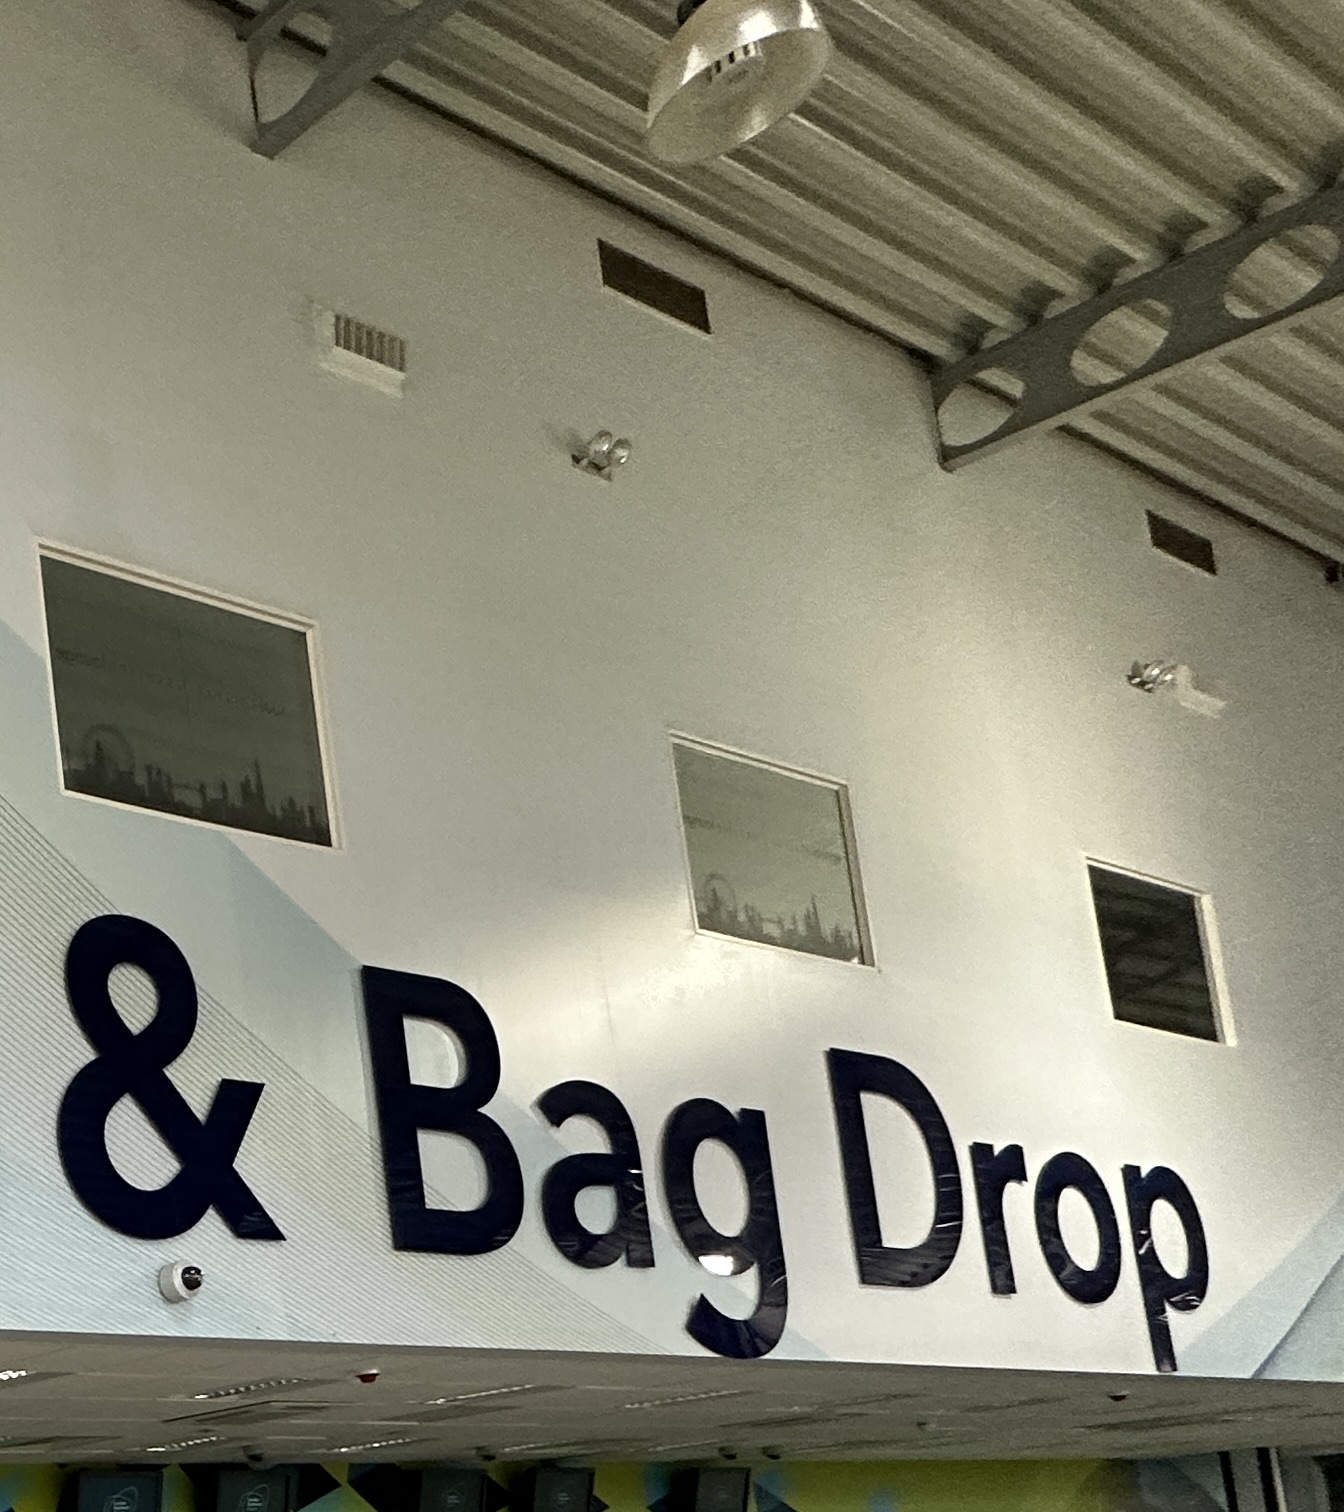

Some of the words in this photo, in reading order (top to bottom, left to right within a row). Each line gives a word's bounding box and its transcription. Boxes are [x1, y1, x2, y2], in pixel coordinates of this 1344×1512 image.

[56, 913, 286, 1241] &
[362, 964, 789, 1359] Bag
[826, 1047, 1210, 1373] Drop
